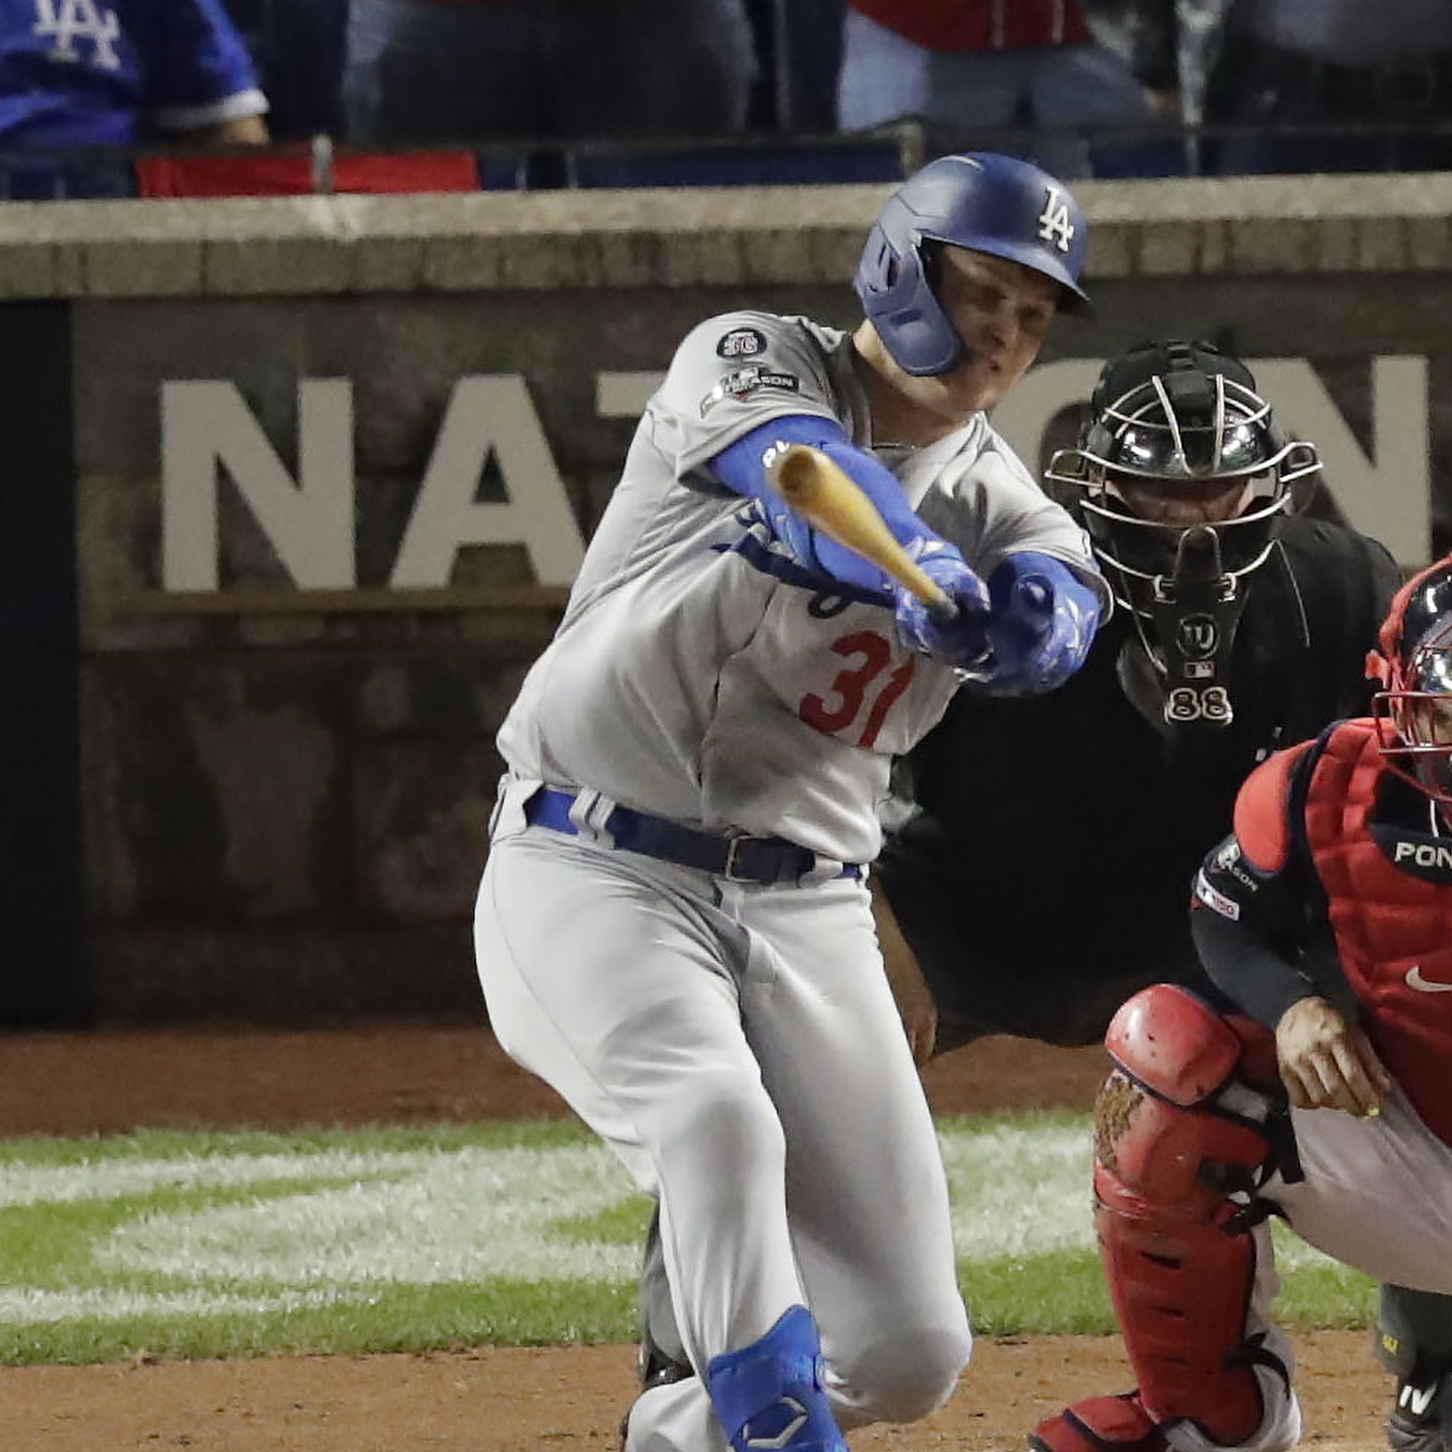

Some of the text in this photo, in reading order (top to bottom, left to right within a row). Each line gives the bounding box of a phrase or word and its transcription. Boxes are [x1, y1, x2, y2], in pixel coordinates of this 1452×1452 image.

[1040, 186, 1075, 252] LA
[800, 630, 916, 749] 31
[1165, 686, 1234, 724] 88
